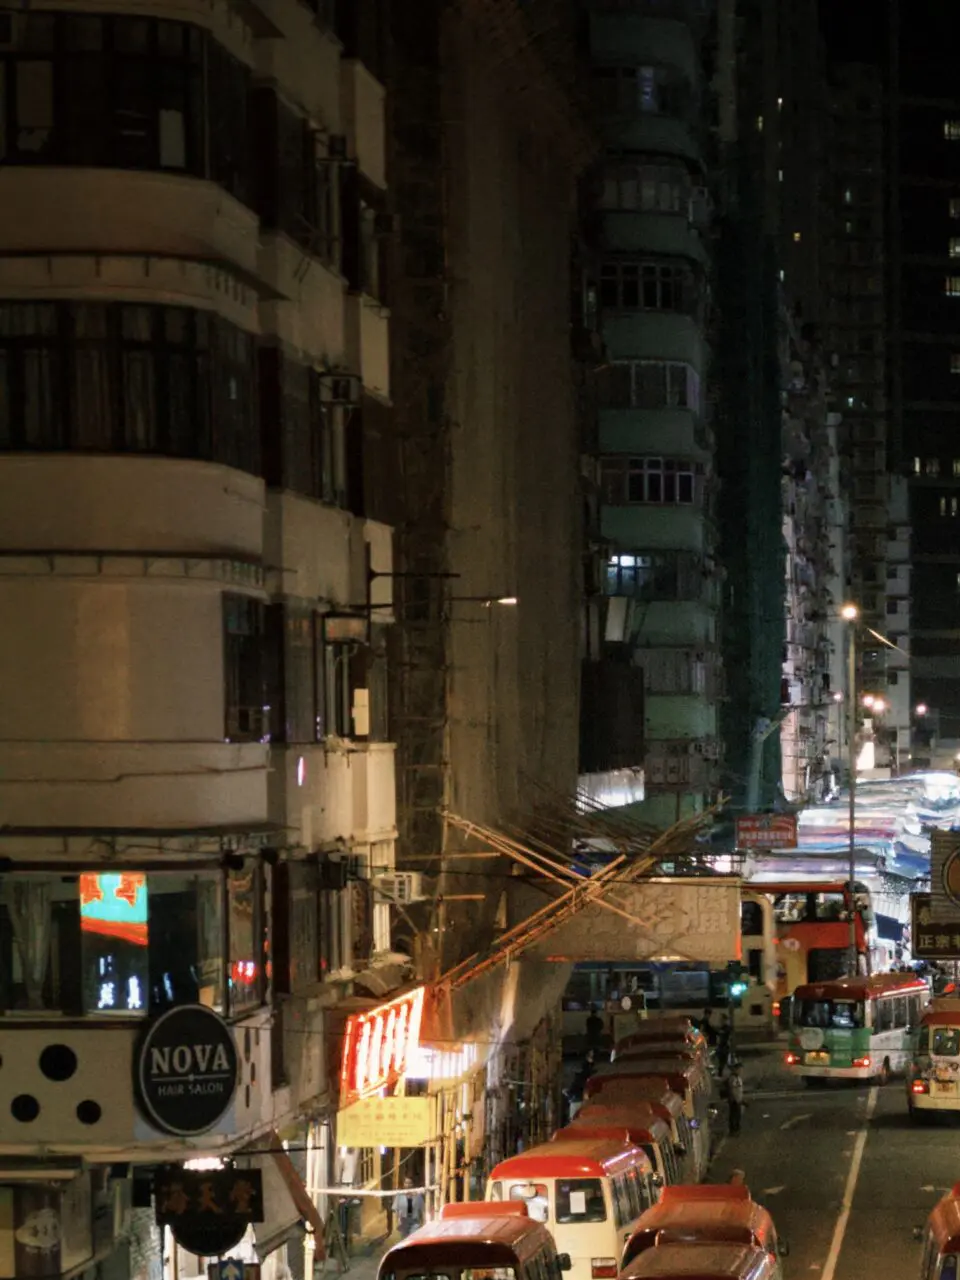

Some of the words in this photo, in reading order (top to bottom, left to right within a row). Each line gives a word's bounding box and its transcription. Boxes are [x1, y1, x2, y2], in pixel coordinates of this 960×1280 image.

[151, 1043, 230, 1074] NOVA
[157, 1084, 184, 1096] HAIR
[188, 1082, 224, 1094] SALON
